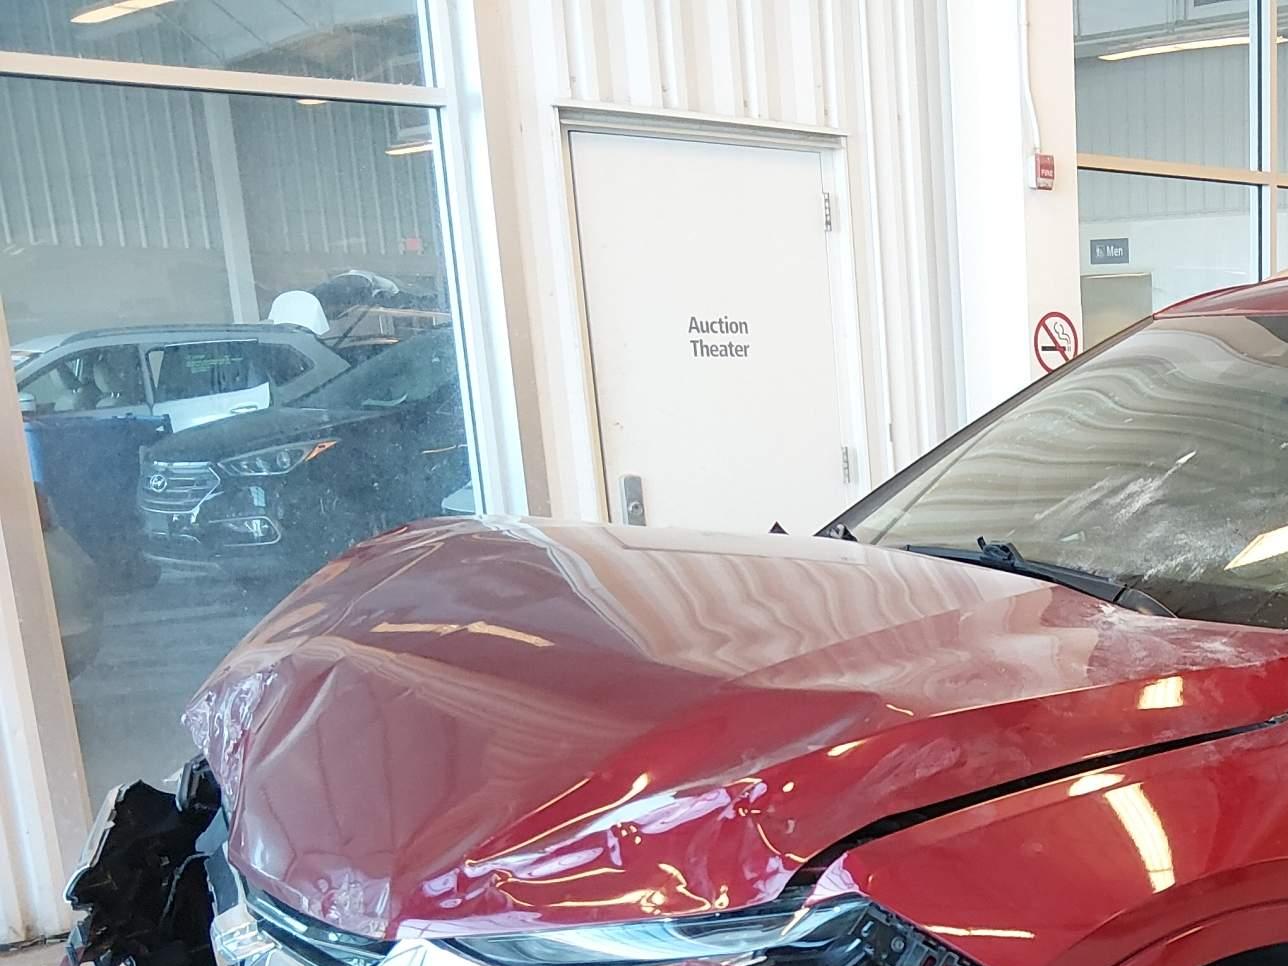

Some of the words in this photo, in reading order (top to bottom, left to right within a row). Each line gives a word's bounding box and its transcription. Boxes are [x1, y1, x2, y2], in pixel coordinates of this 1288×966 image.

[1106, 245, 1124, 257] Men
[688, 315, 748, 334] Auction
[689, 338, 749, 357] Theater
